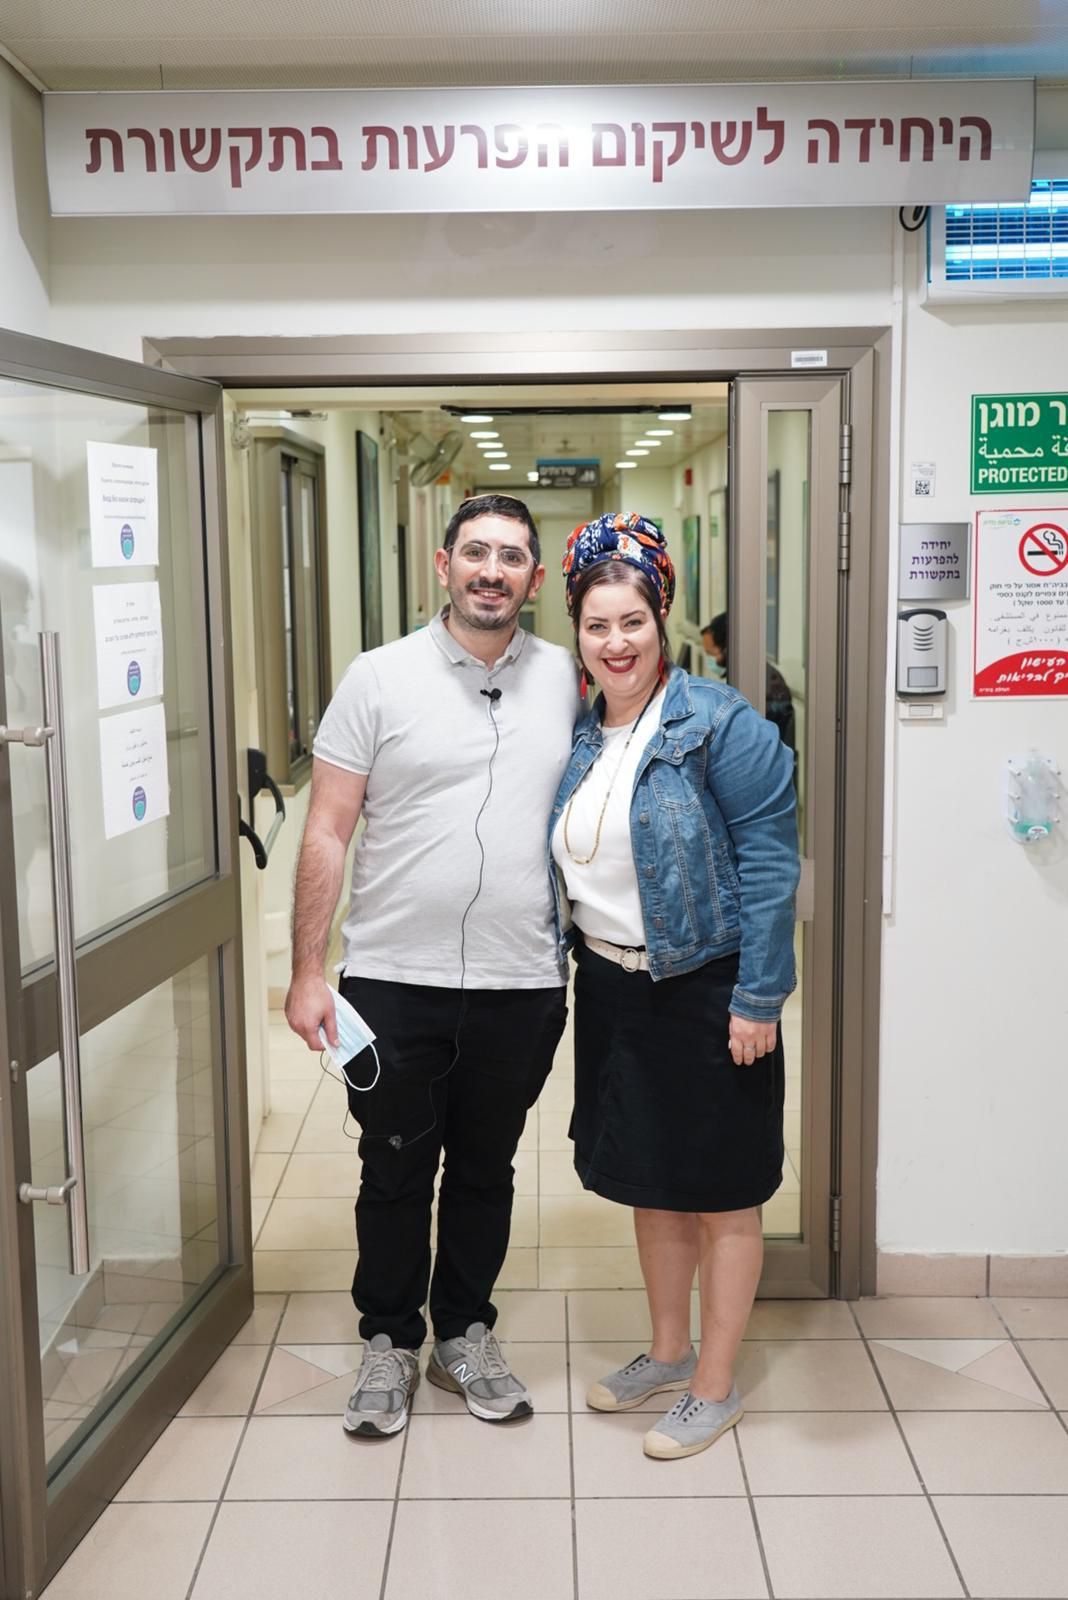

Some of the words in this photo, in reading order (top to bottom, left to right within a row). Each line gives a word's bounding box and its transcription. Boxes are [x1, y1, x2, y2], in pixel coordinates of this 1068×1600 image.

[361, 123, 569, 173] הפרעות
[591, 106, 786, 183] לשיקום
[808, 116, 992, 164] היחידה
[85, 126, 343, 189] בתקשורת
[979, 401, 1041, 434] מוגן
[978, 437, 1044, 465] محمية
[978, 466, 1068, 484] PROTECTED
[921, 541, 951, 550] יחידה
[911, 553, 959, 565] להפרעות
[909, 570, 960, 581] בתקשורת
[996, 669, 1055, 683] לבריאות
[453, 1363, 474, 1384] N
